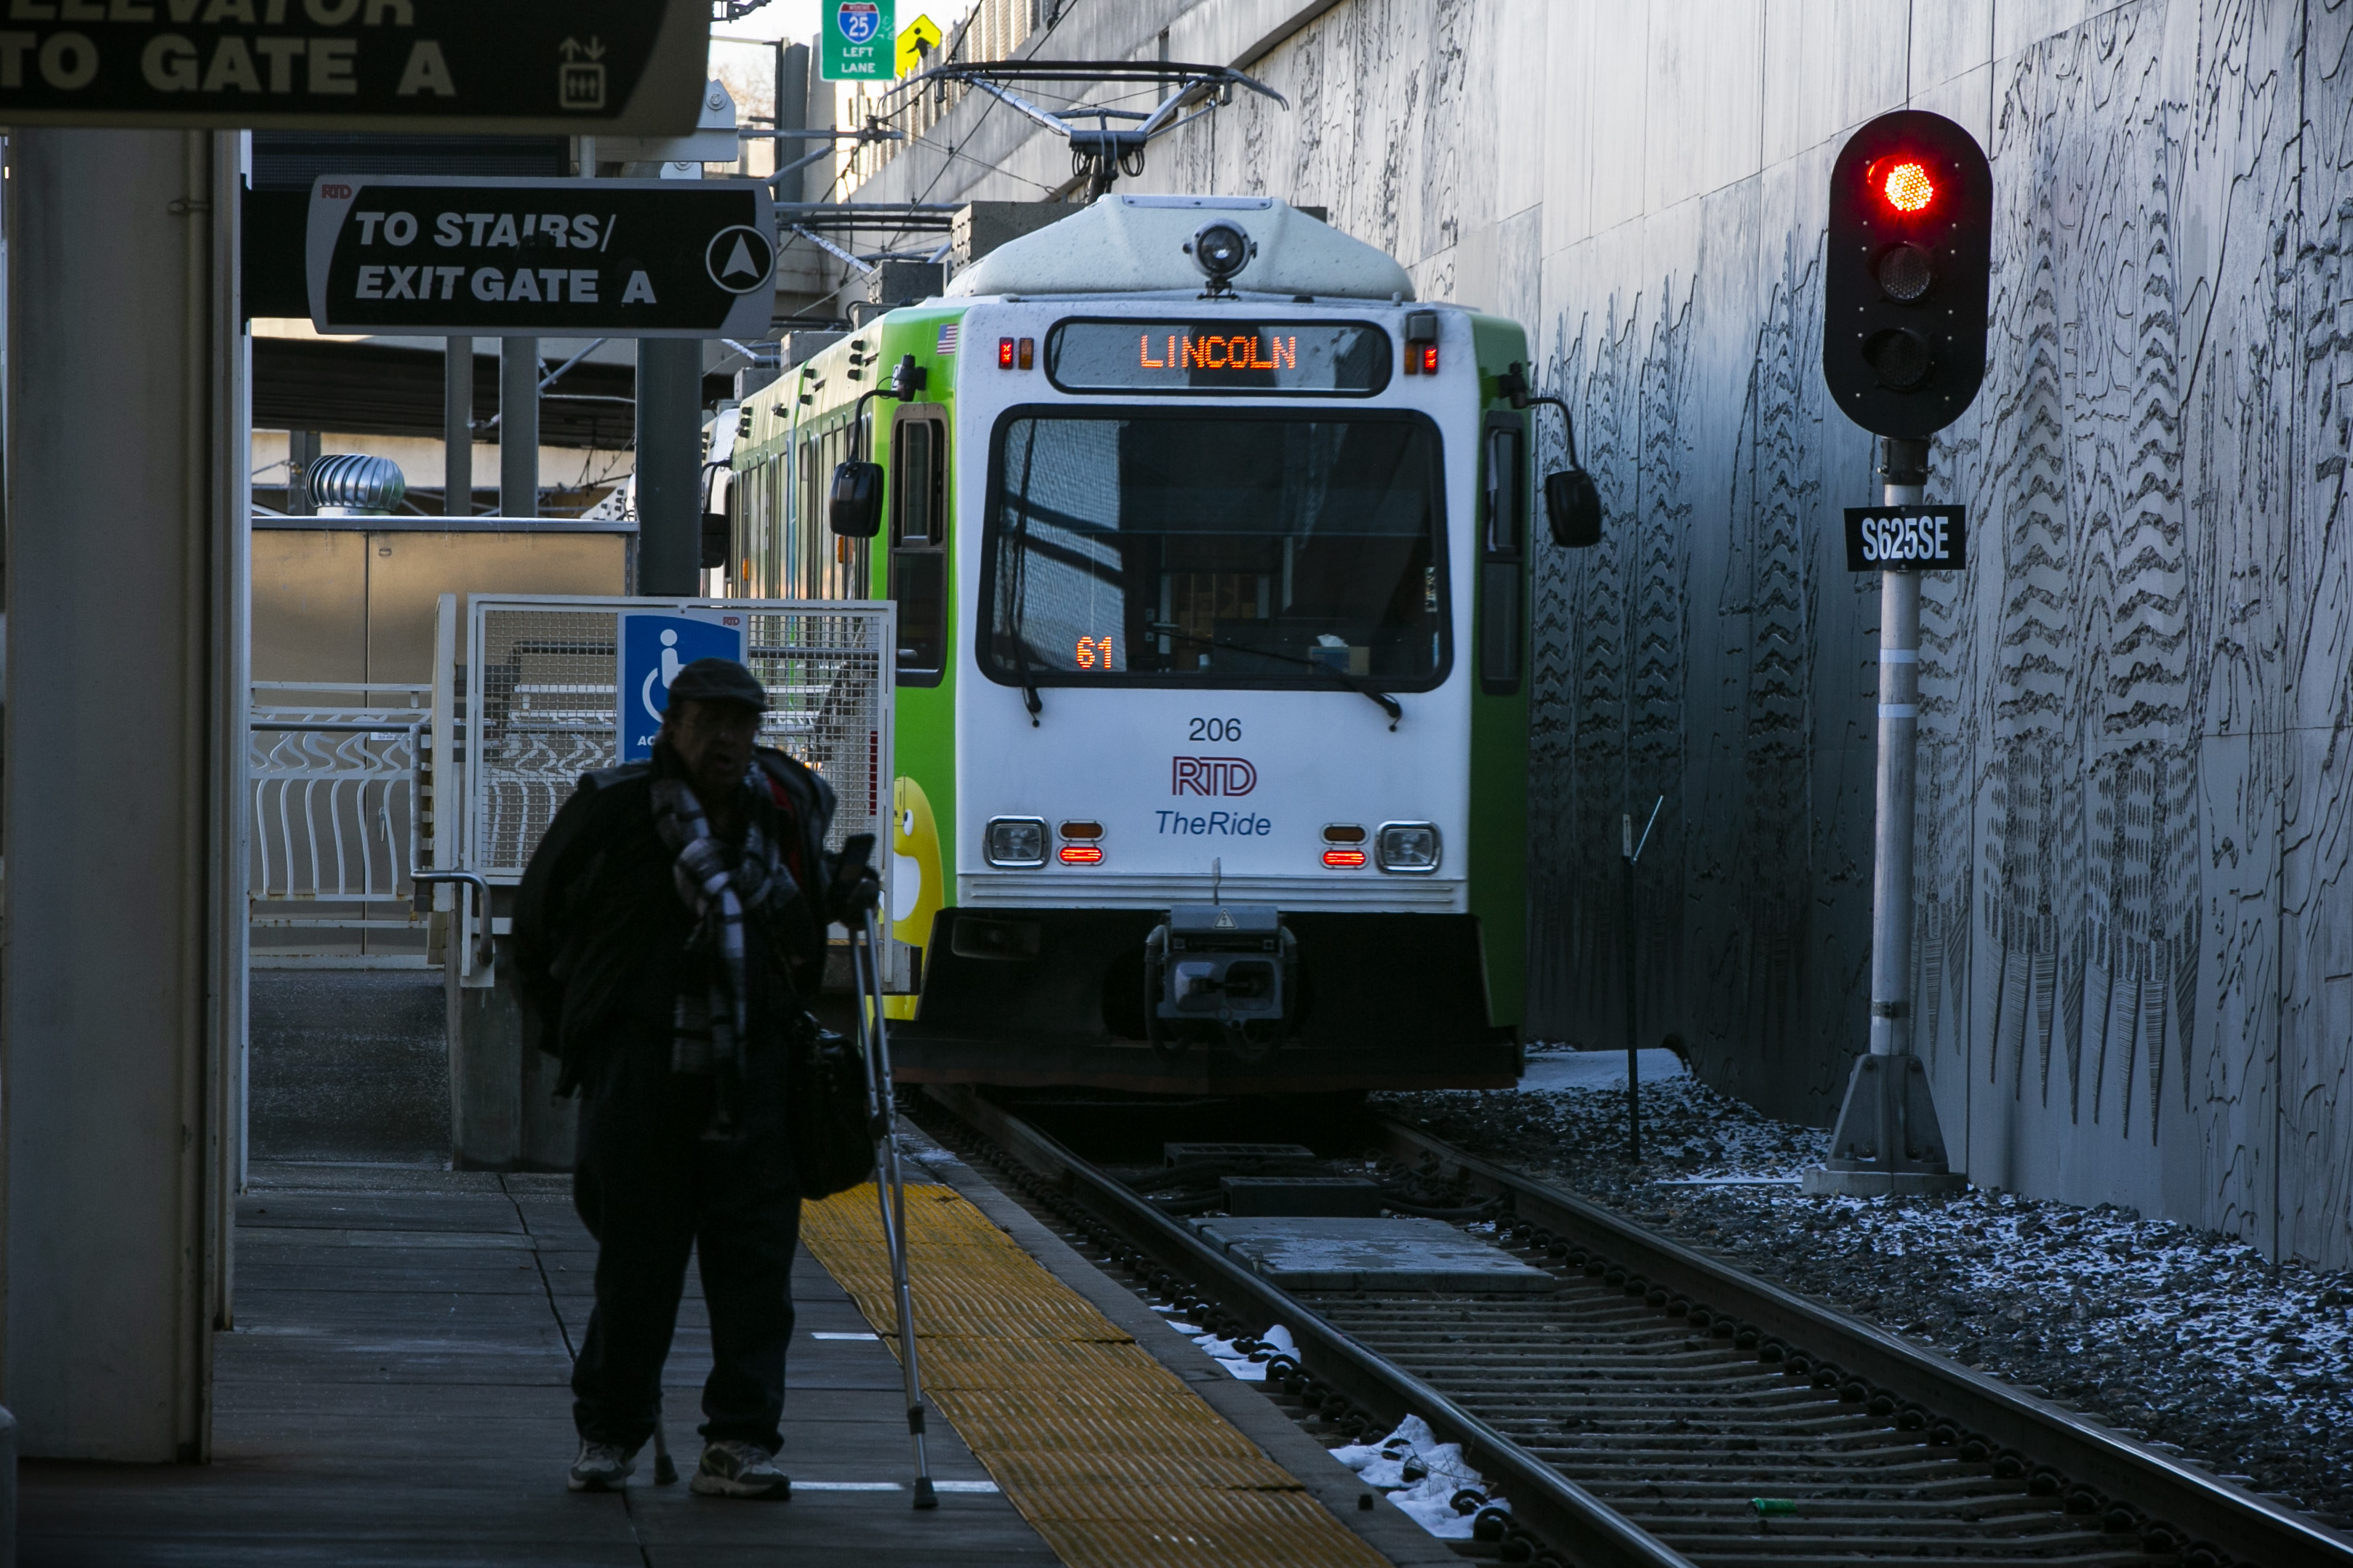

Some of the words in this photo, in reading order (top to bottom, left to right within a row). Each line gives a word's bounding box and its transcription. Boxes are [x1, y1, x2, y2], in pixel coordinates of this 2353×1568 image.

[849, 16, 869, 37] 25
[0, 31, 99, 90] TO
[140, 33, 358, 95] GATE
[396, 39, 457, 97] A
[841, 63, 875, 73] LANE
[843, 47, 874, 57] LEFT
[321, 184, 352, 199] RTD
[356, 212, 418, 246] TO
[433, 213, 617, 252] STAIRS/
[355, 265, 466, 299] EXIT
[470, 268, 598, 303] GATE
[622, 270, 657, 304] A
[1141, 334, 1296, 370] LINCOLN
[1861, 515, 1949, 561] S625SE
[1076, 635, 1113, 670] 61
[1189, 717, 1242, 742] 206
[1172, 756, 1257, 797] RTD
[1155, 811, 1272, 836] TheRide
